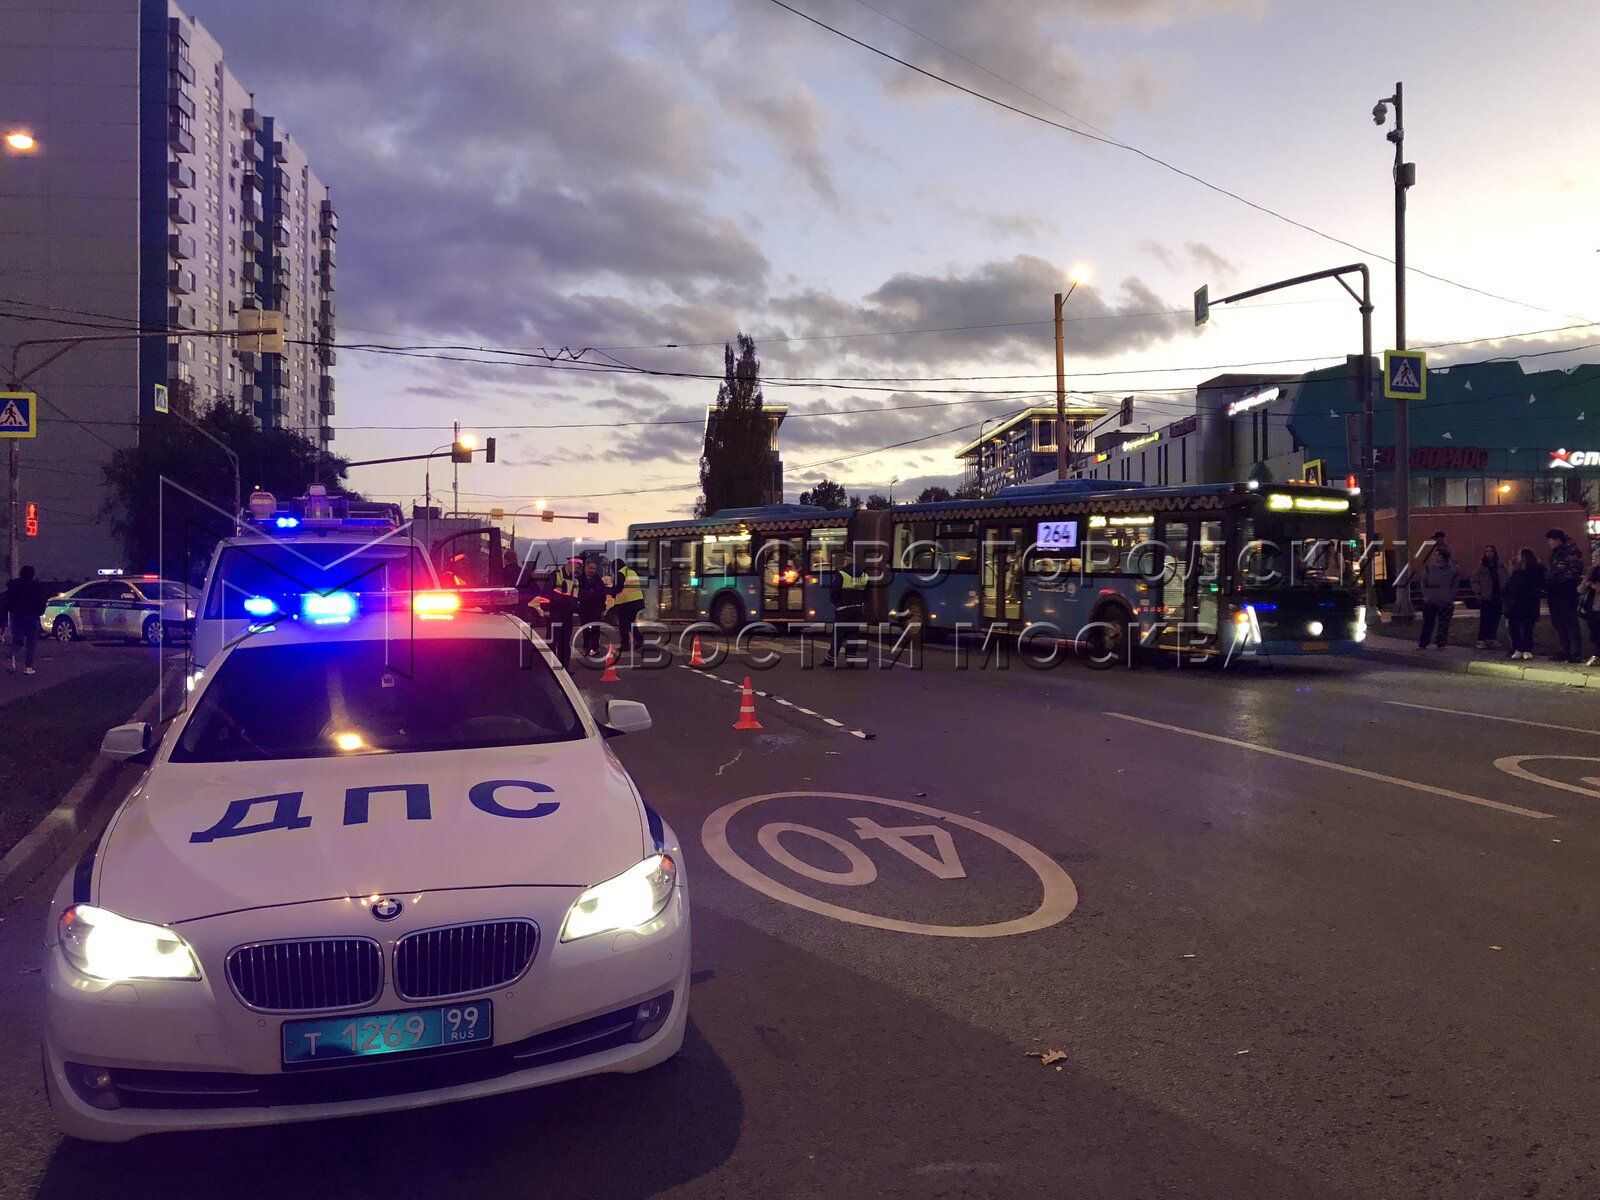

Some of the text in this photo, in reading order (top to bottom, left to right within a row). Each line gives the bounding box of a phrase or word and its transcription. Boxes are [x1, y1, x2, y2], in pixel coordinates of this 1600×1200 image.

[1570, 451, 1600, 466] СП
[1044, 525, 1070, 544] 264
[189, 779, 560, 843] ДПС
[342, 1016, 425, 1052] 1269
[446, 1007, 479, 1030] 99
[451, 1030, 476, 1041] RUS
